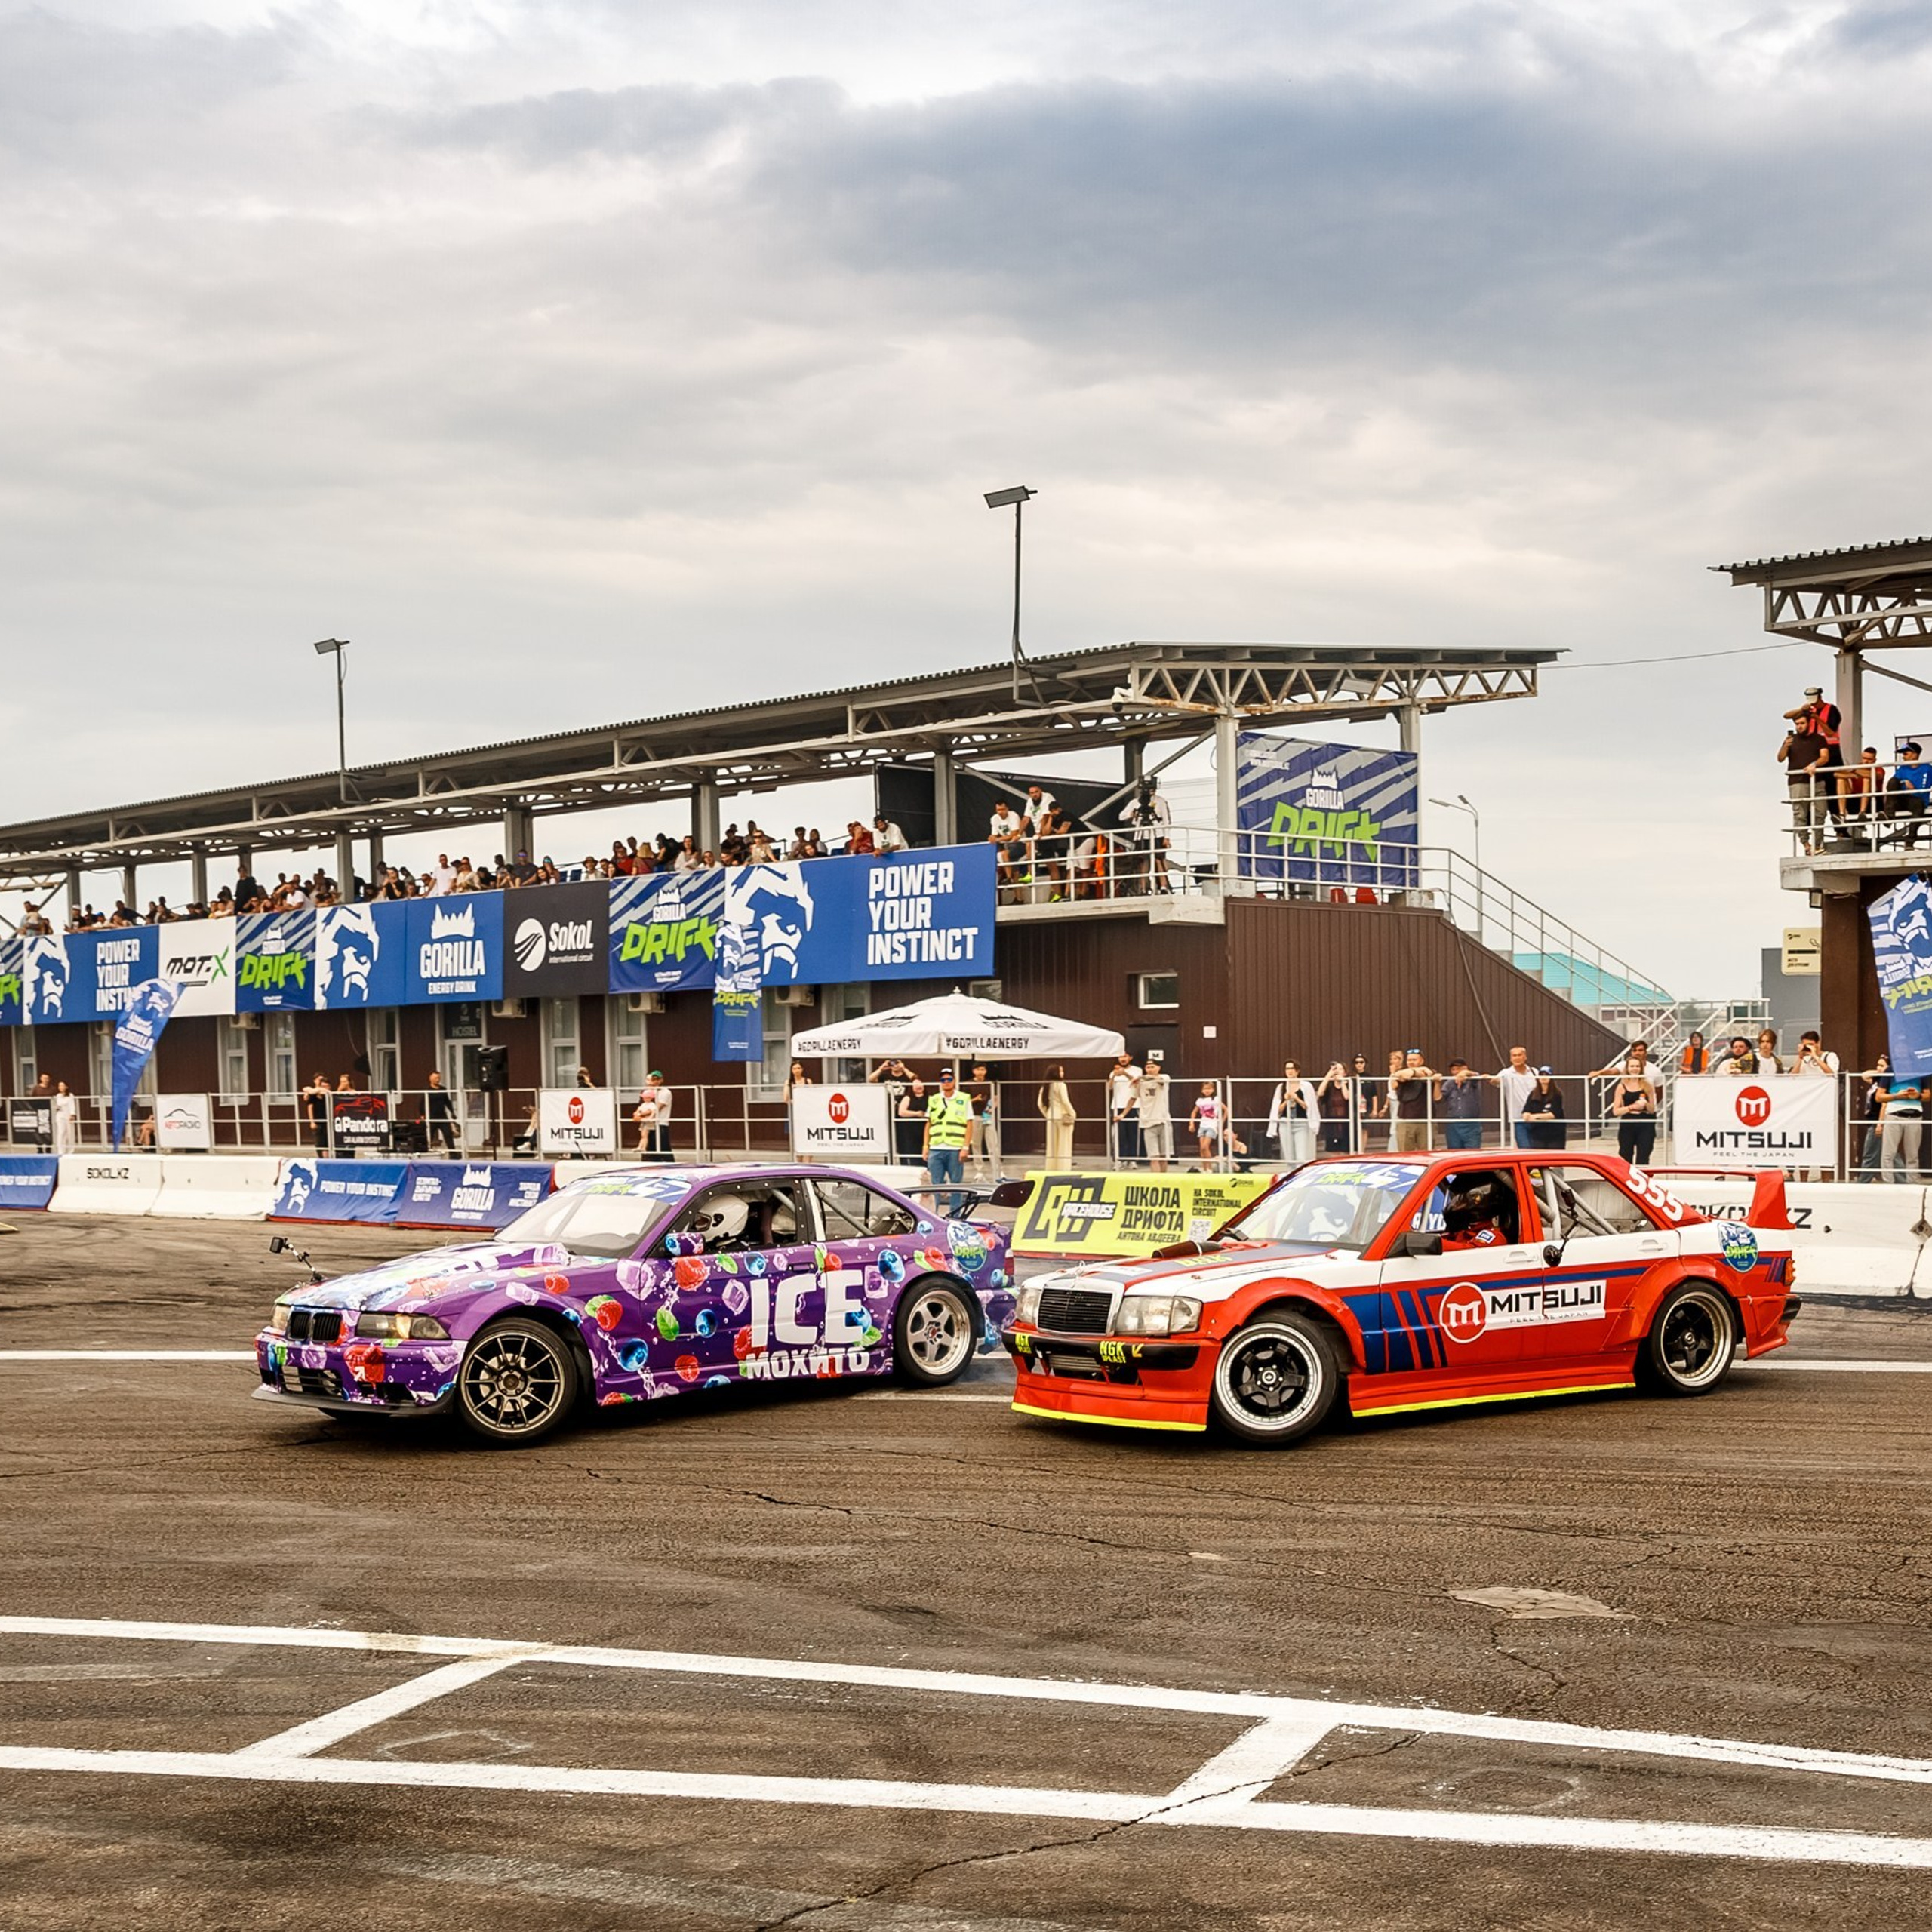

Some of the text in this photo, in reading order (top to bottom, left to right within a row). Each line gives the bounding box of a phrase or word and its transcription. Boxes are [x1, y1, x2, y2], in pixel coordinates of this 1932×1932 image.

[1306, 788, 1344, 810] GORILLA
[1266, 801, 1381, 863] DRIFT
[869, 861, 955, 900] POWER
[652, 903, 687, 923] GORILLA
[868, 897, 932, 932] YOUR
[96, 938, 140, 965] POWER
[619, 915, 718, 965] DRIFT
[867, 927, 979, 965] INSTINCT
[238, 951, 307, 990] DRIFT
[420, 940, 485, 978] GORILLA
[96, 963, 130, 988] YOUR
[715, 992, 759, 1009] DRIFT
[115, 1026, 155, 1051] GORILLA
[343, 1117, 389, 1133] Pandora
[551, 1128, 604, 1139] MITSUJI
[807, 1128, 875, 1140] MITSUJI
[1696, 1131, 1813, 1149] MITSUJI
[451, 1187, 495, 1211] GORILLA
[1124, 1186, 1181, 1208] ШКОЛА
[1192, 1198, 1242, 1209] INTERNATIONAL
[1204, 1189, 1225, 1198] SOKOL
[1626, 1164, 1684, 1222] 555
[1121, 1209, 1184, 1232] ДРИФТА
[1192, 1208, 1217, 1217] CIRCUIT
[1117, 1231, 1182, 1243] АНТОНА АВДЕЕВА
[750, 1269, 863, 1348] ICE
[1491, 1285, 1601, 1315] MITSUJI
[1100, 1340, 1126, 1356] NGK
